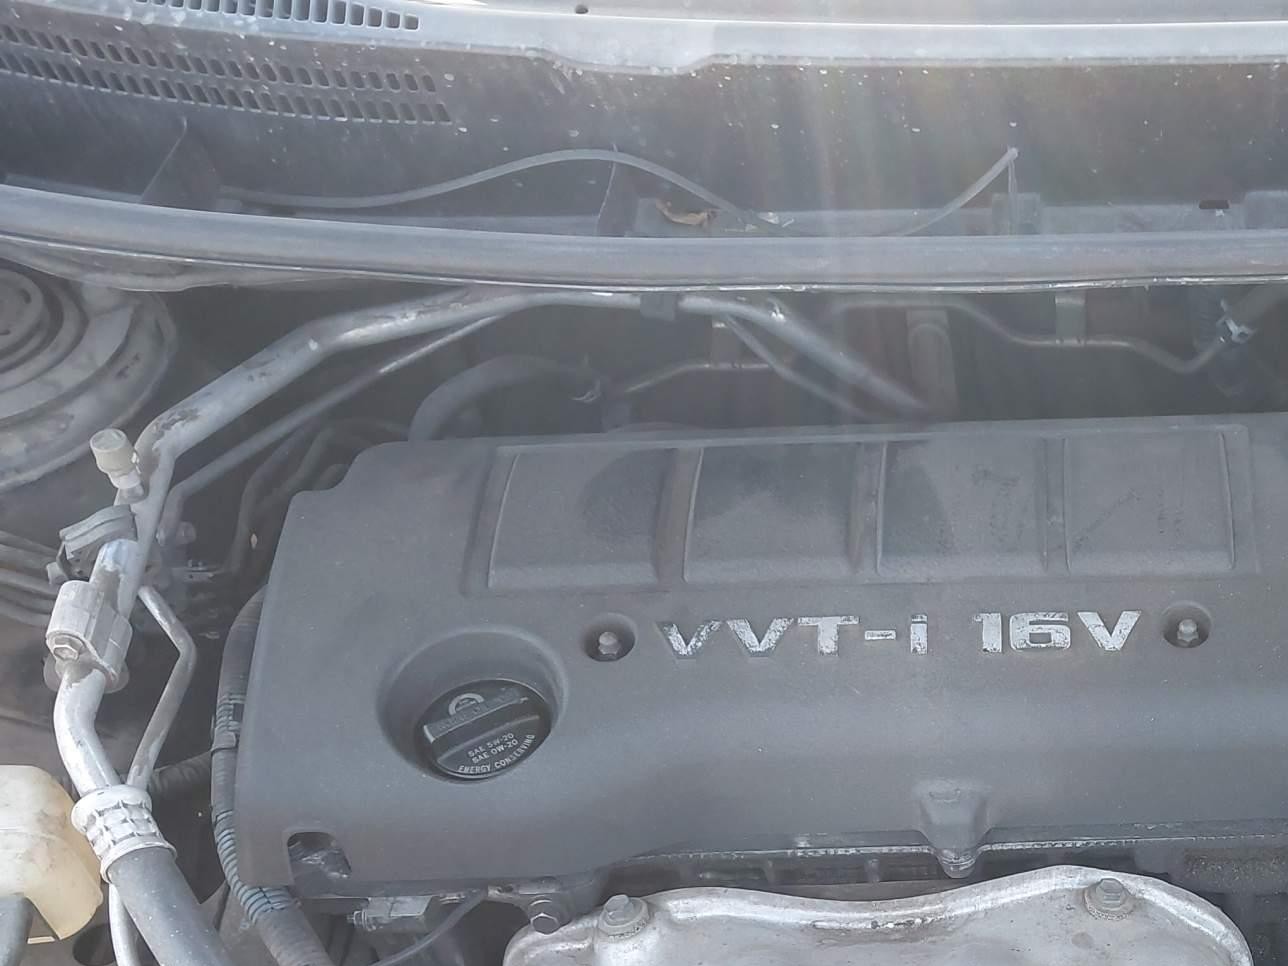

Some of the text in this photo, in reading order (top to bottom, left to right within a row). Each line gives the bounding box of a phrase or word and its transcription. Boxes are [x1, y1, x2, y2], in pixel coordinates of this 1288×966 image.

[655, 610, 1142, 660] VVT-i 16V
[457, 734, 536, 774] ENERGY CONSERVING
[486, 733, 514, 748] 5W-20
[471, 751, 490, 764] SAE
